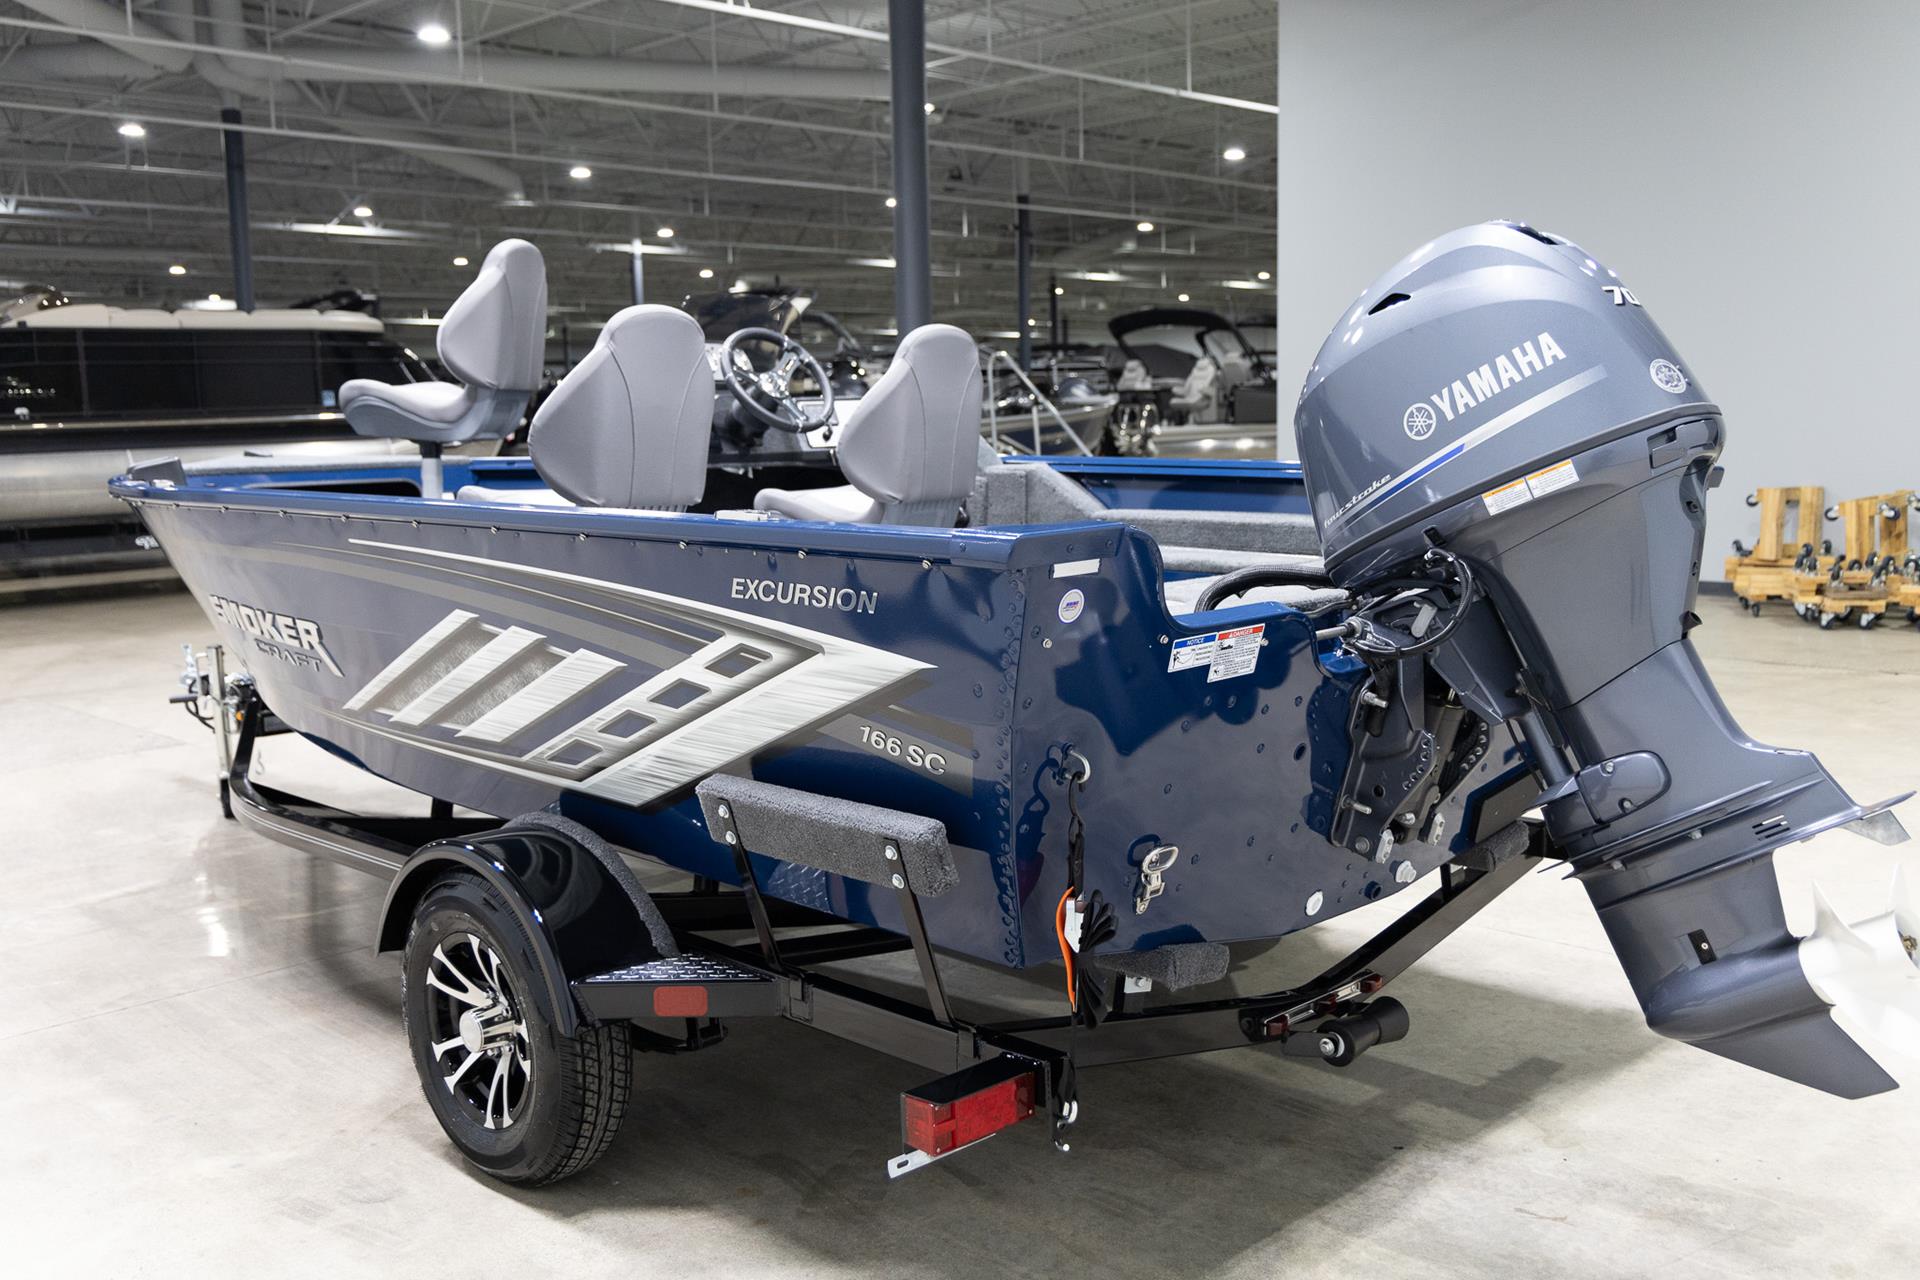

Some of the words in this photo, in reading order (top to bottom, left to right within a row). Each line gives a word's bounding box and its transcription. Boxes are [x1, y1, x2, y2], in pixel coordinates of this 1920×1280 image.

[1601, 285, 1641, 307] 70
[1430, 332, 1567, 422] YAMAHA
[731, 577, 879, 614] EXCURSION
[254, 637, 322, 672] CRAFT
[1186, 637, 1205, 647] NOTICE
[859, 725, 903, 758] 166
[906, 744, 947, 776] SC
